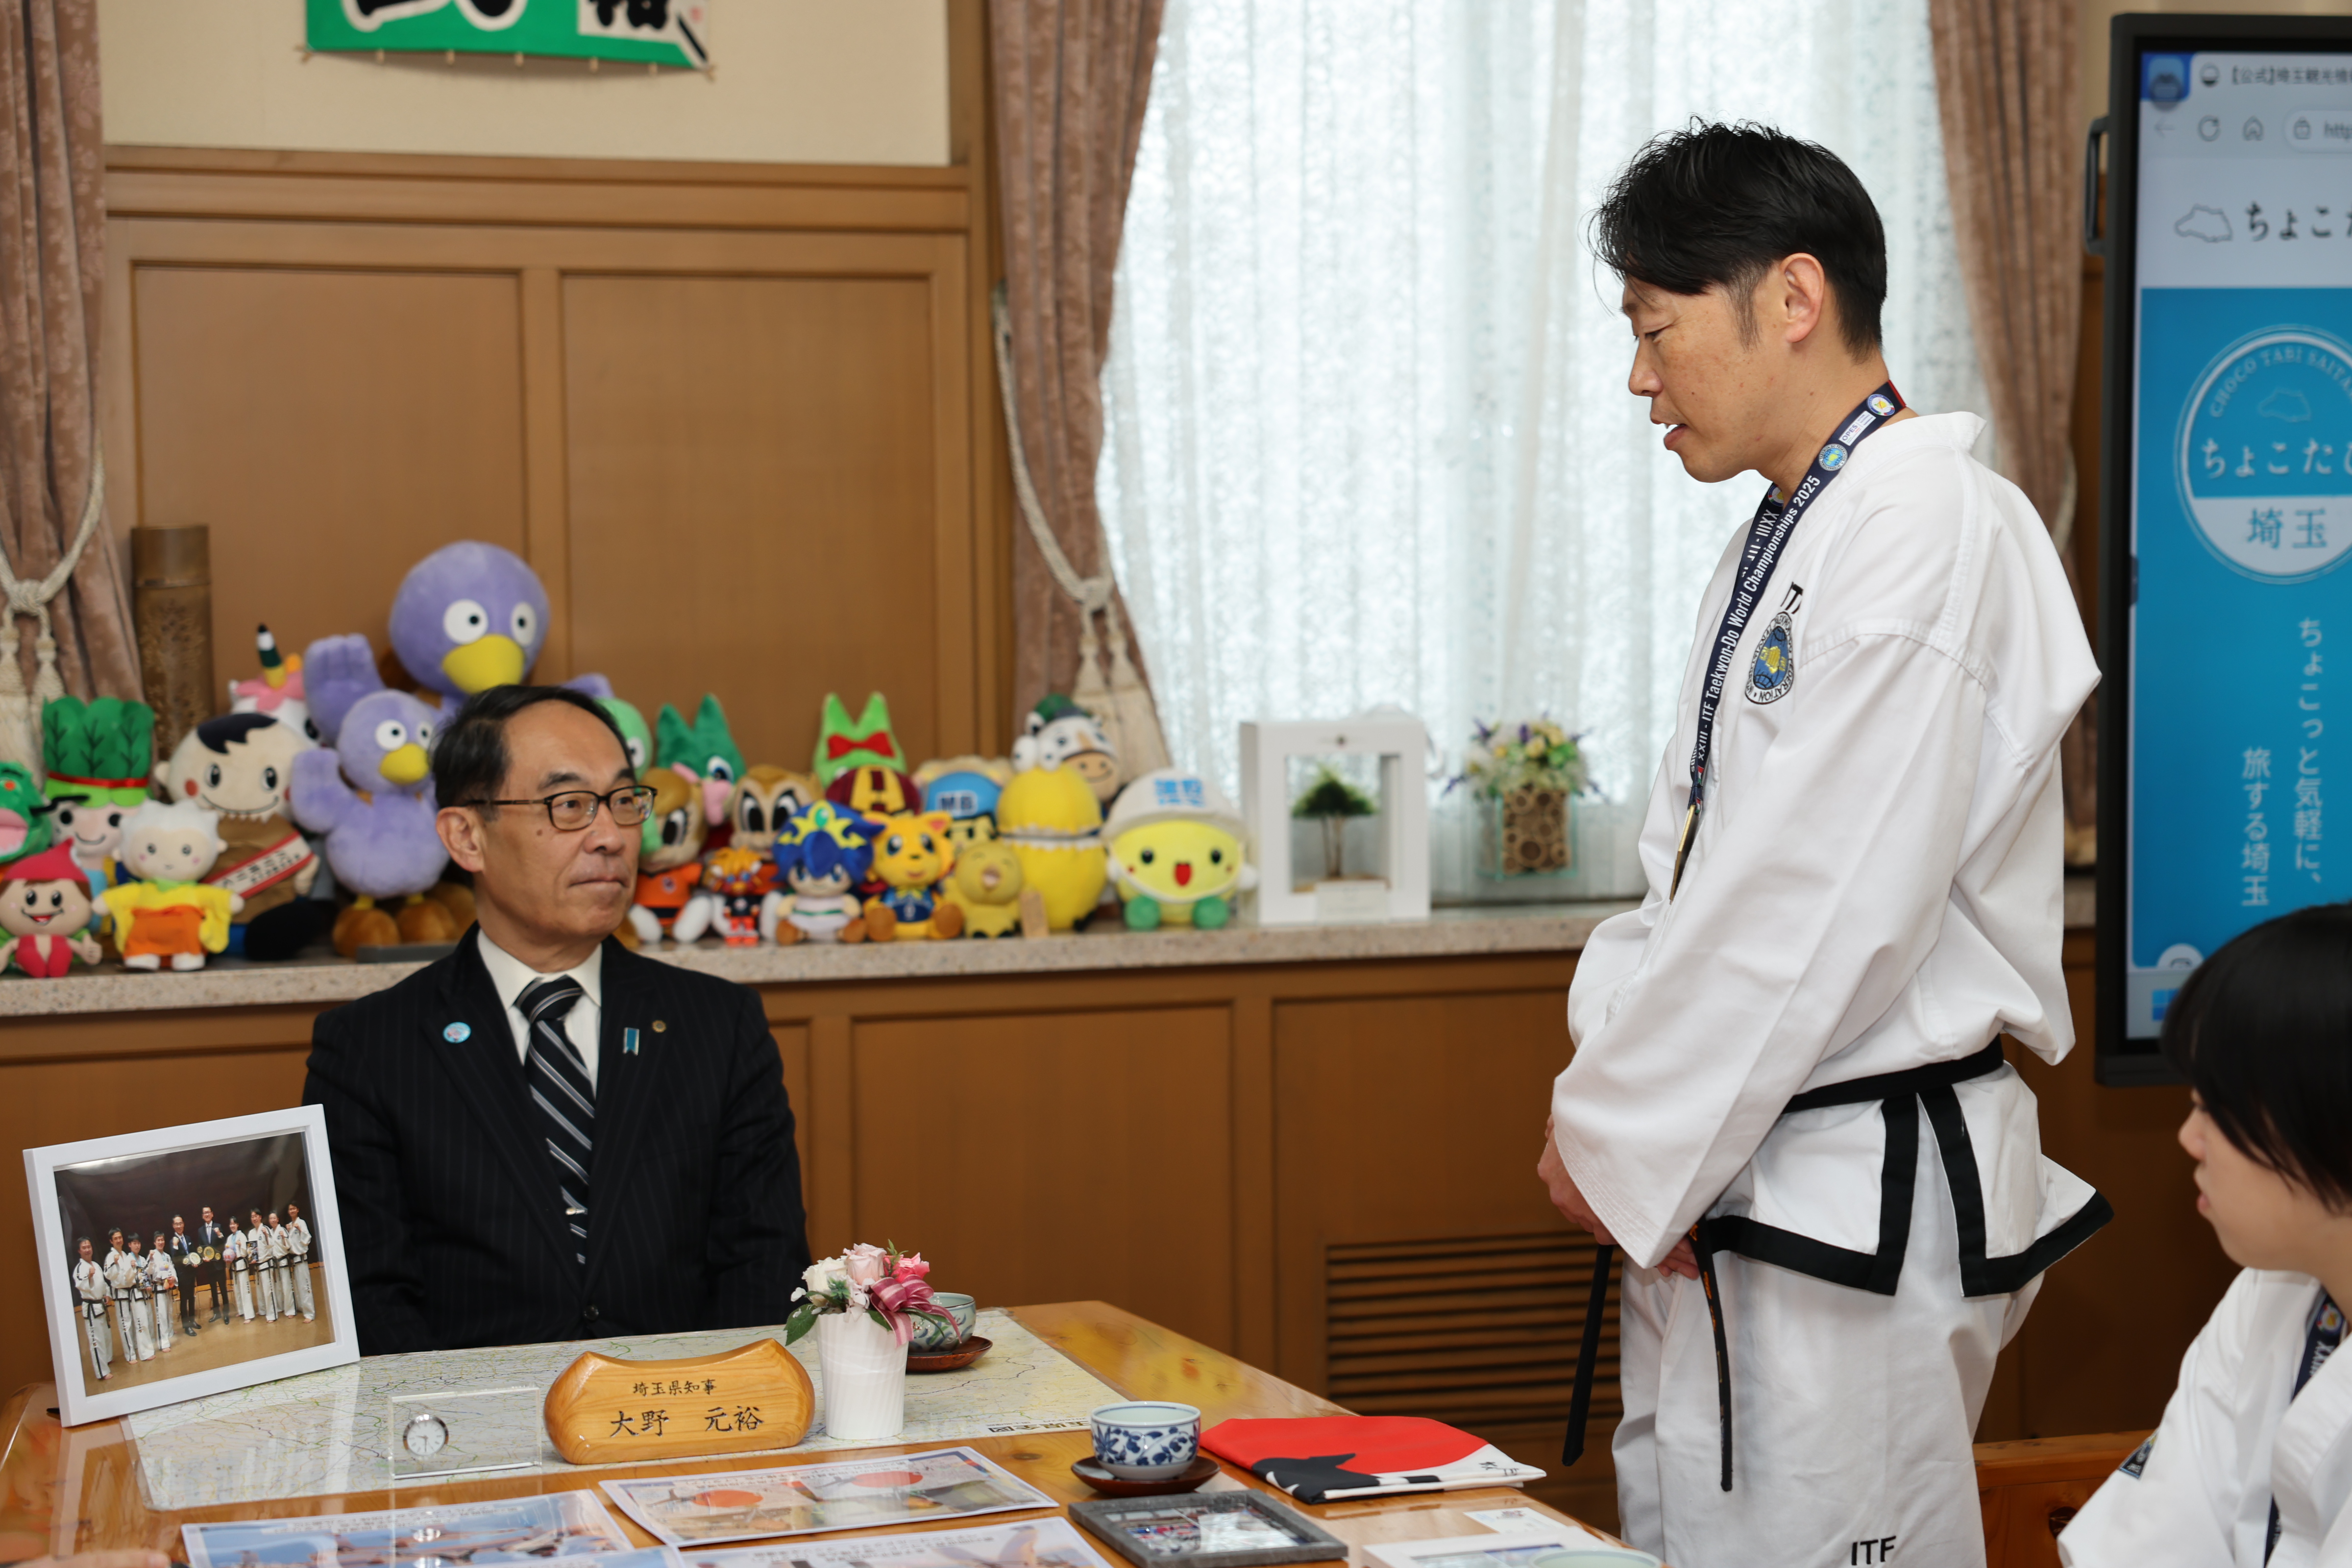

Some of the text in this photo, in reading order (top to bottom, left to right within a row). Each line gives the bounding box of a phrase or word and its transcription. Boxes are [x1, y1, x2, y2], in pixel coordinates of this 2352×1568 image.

[2210, 344, 2352, 417] CHOCO TABI SAITA
[1842, 424, 1858, 441] OPES
[1793, 475, 1820, 507] 2025
[2247, 507, 2327, 549] 埼玉
[1743, 508, 1798, 591] Championships
[1727, 591, 1753, 628] World
[1706, 630, 1740, 700] Taekwon-Do
[1702, 702, 1714, 722] ITF
[2293, 617, 2324, 883] ちょこっと気軽に、
[2241, 747, 2271, 906] 旅する埼玉
[633, 1379, 716, 1396] 埼玉県知事
[610, 1406, 764, 1437] 大野 元裕
[1851, 1535, 1896, 1566] ITF
